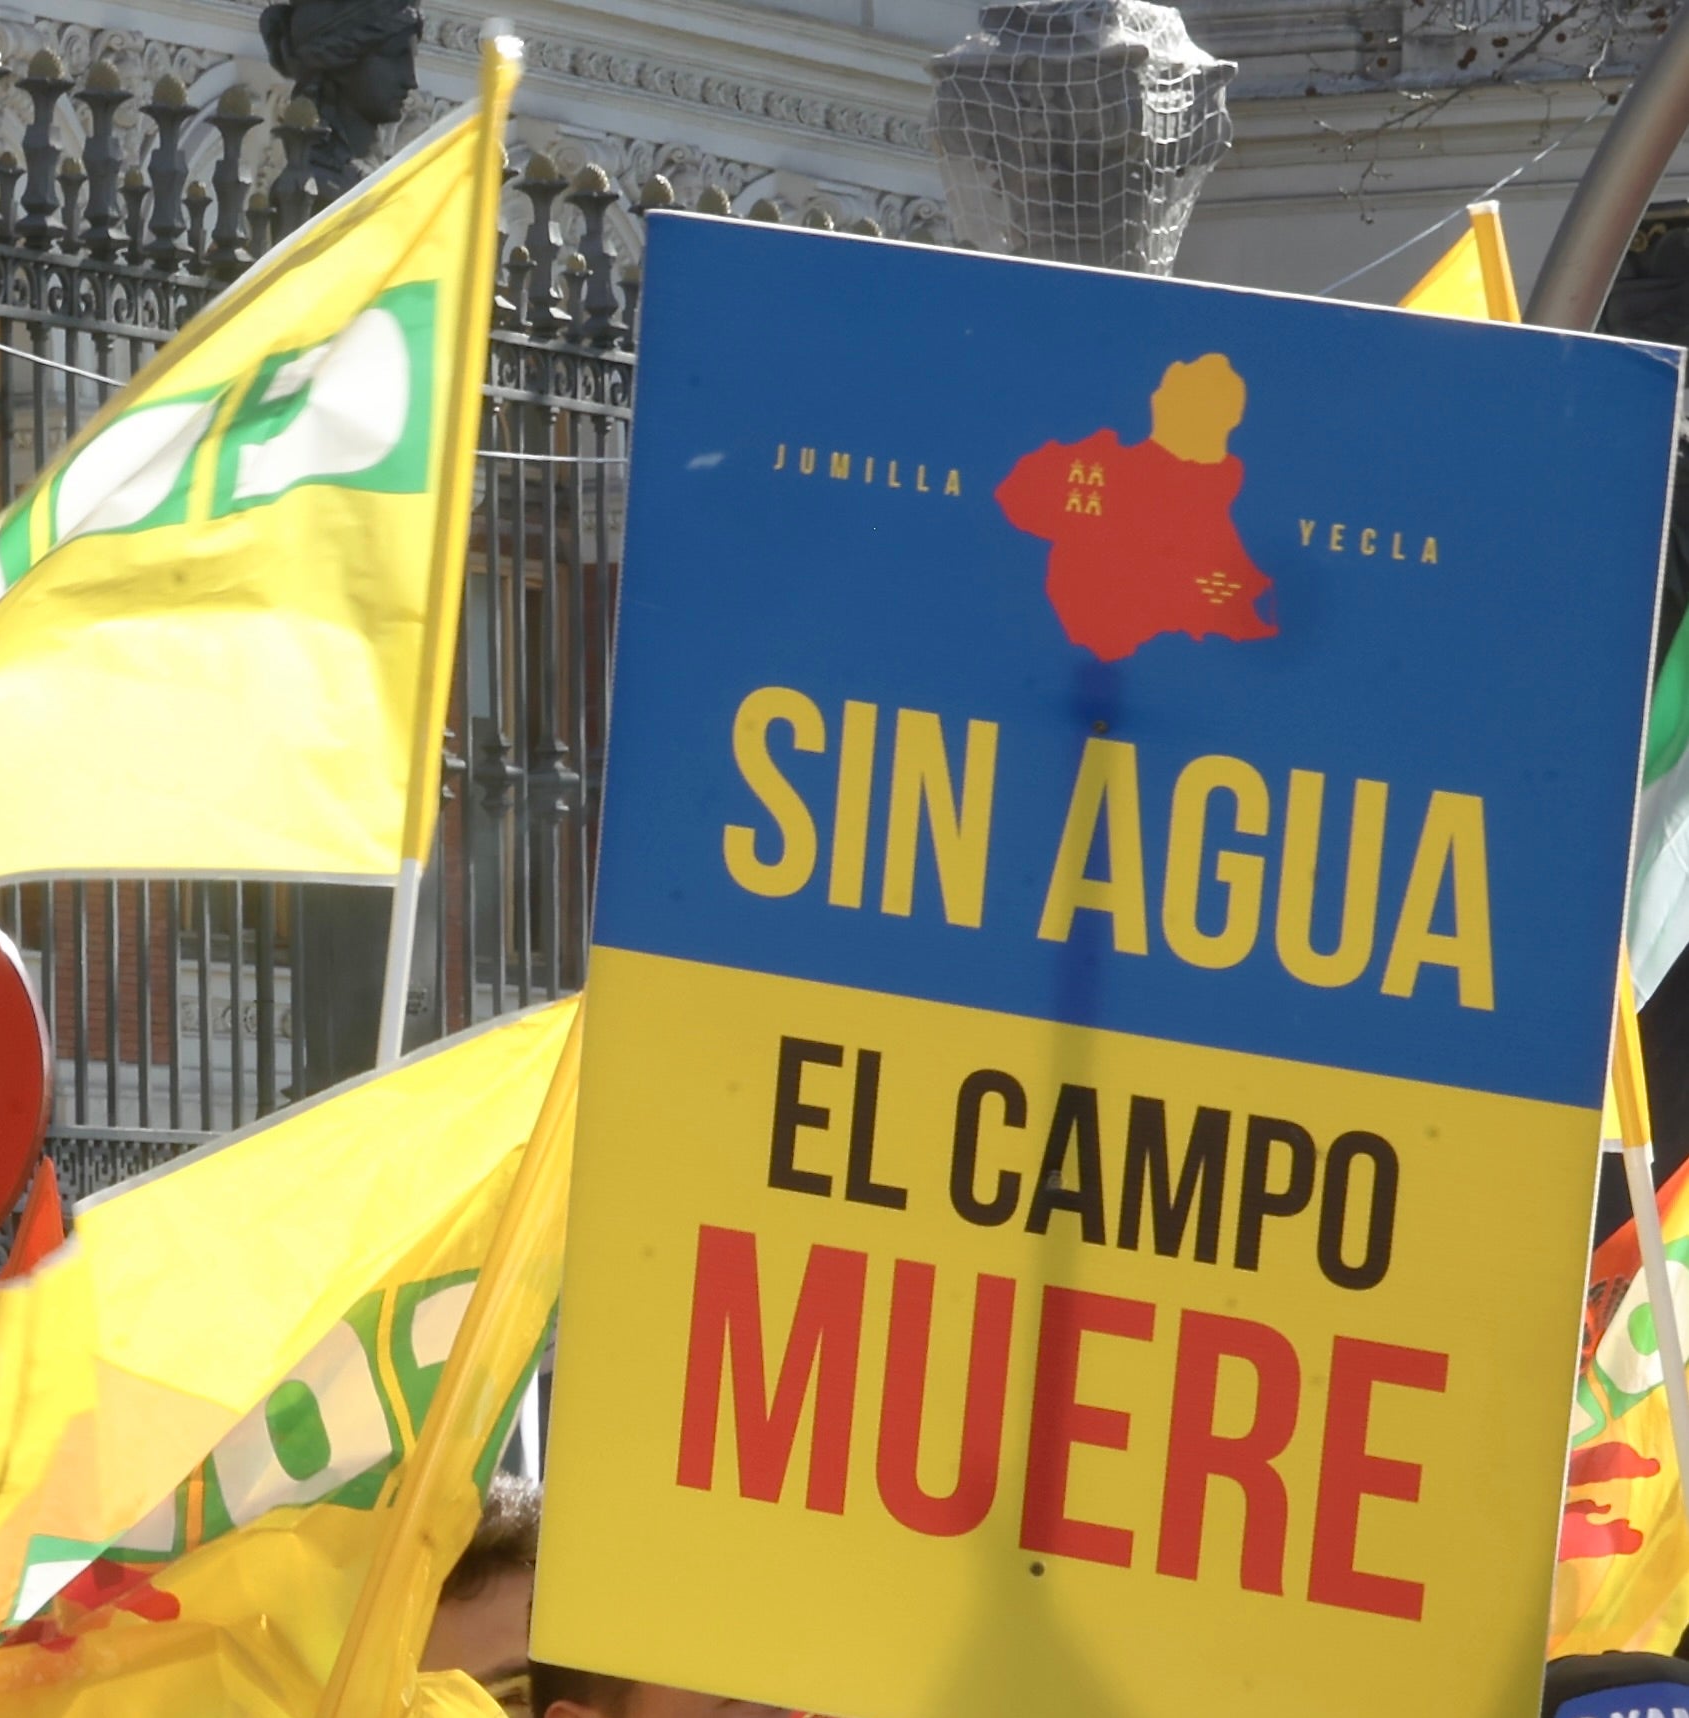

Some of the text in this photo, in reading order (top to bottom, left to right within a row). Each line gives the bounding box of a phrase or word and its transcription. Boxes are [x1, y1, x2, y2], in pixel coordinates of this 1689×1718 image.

[774, 444, 961, 497] JUMILLA
[1299, 519, 1438, 564] YECLA
[722, 685, 1496, 1012] SIN AGUA
[767, 1034, 1400, 1292] EL CAMPO
[675, 1223, 1451, 1623] MUERE
